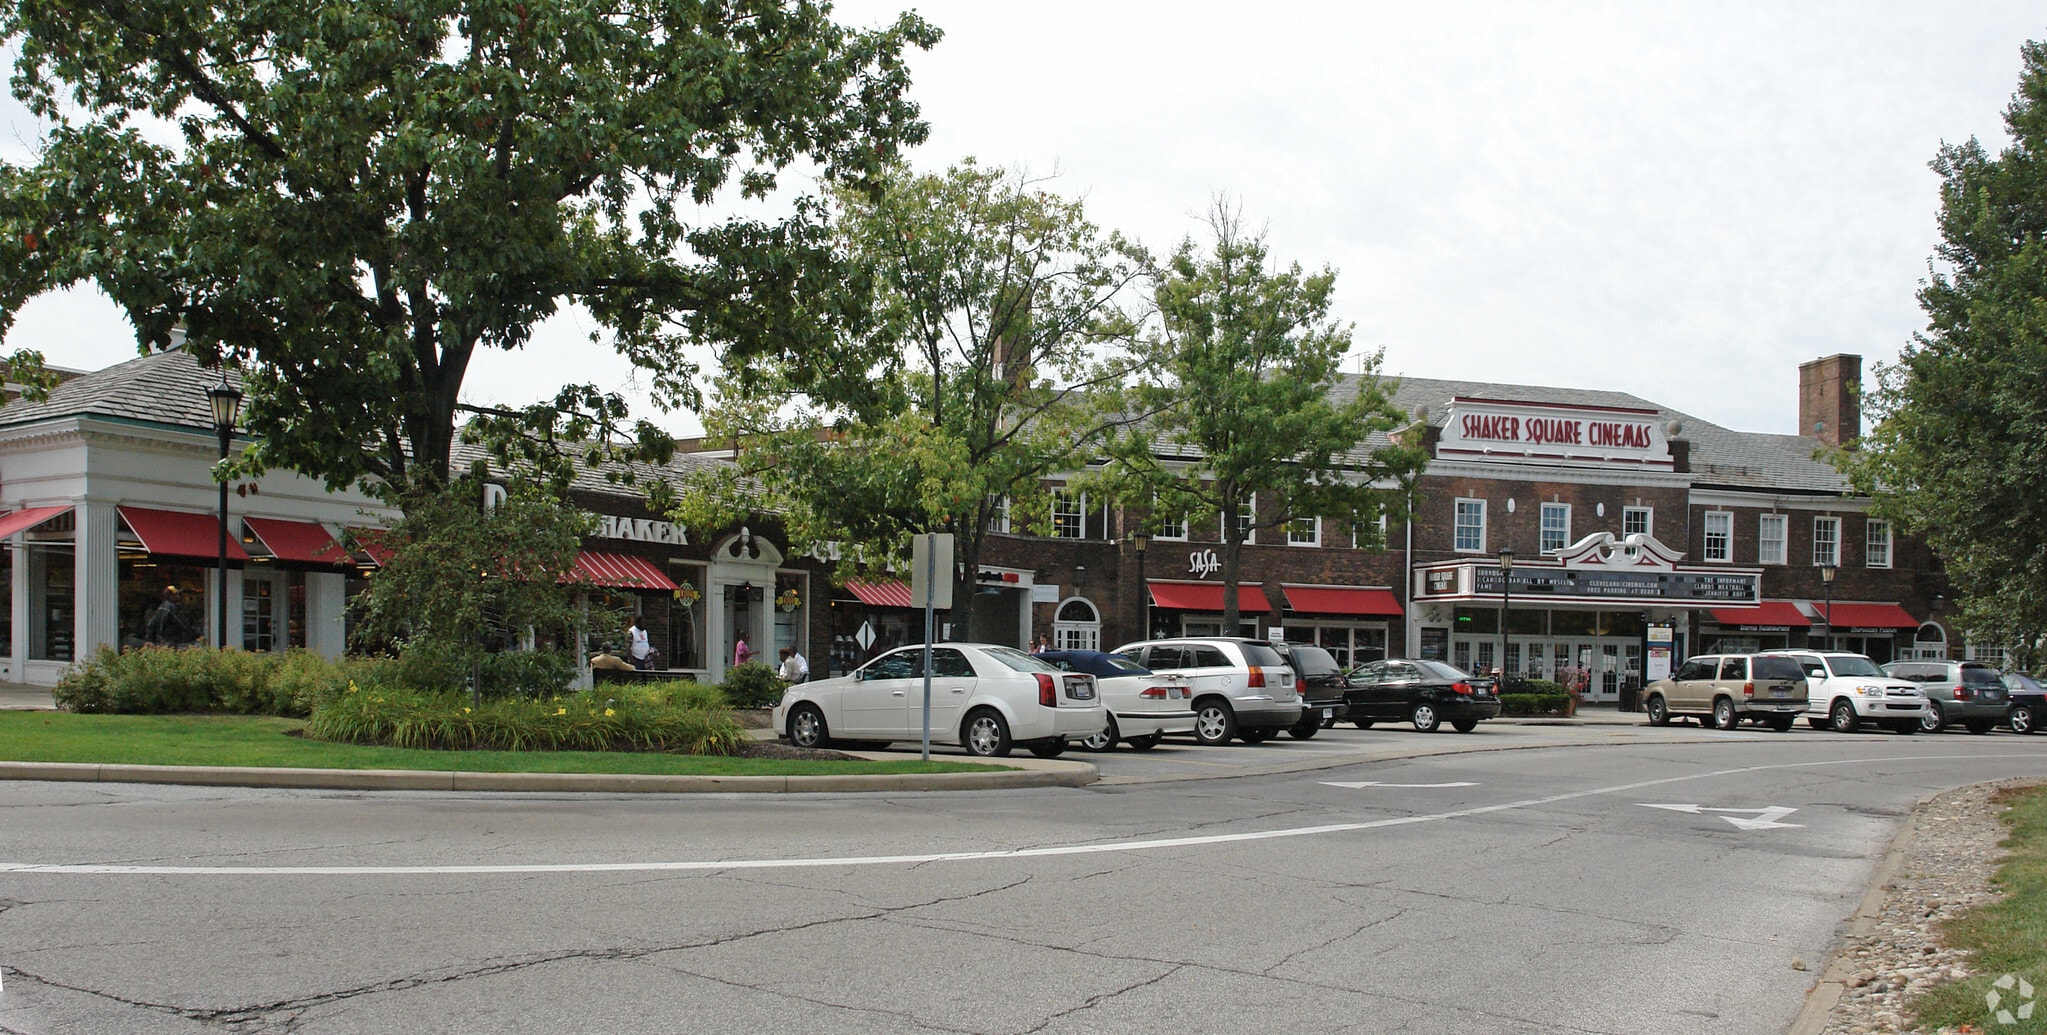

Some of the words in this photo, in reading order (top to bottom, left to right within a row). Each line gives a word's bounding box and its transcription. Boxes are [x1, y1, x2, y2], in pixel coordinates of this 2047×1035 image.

[1462, 414, 1519, 441] SHAKER
[1525, 418, 1582, 445] SQUARE
[1588, 422, 1651, 448] CINEMAS
[1522, 577, 1533, 585] ALL
